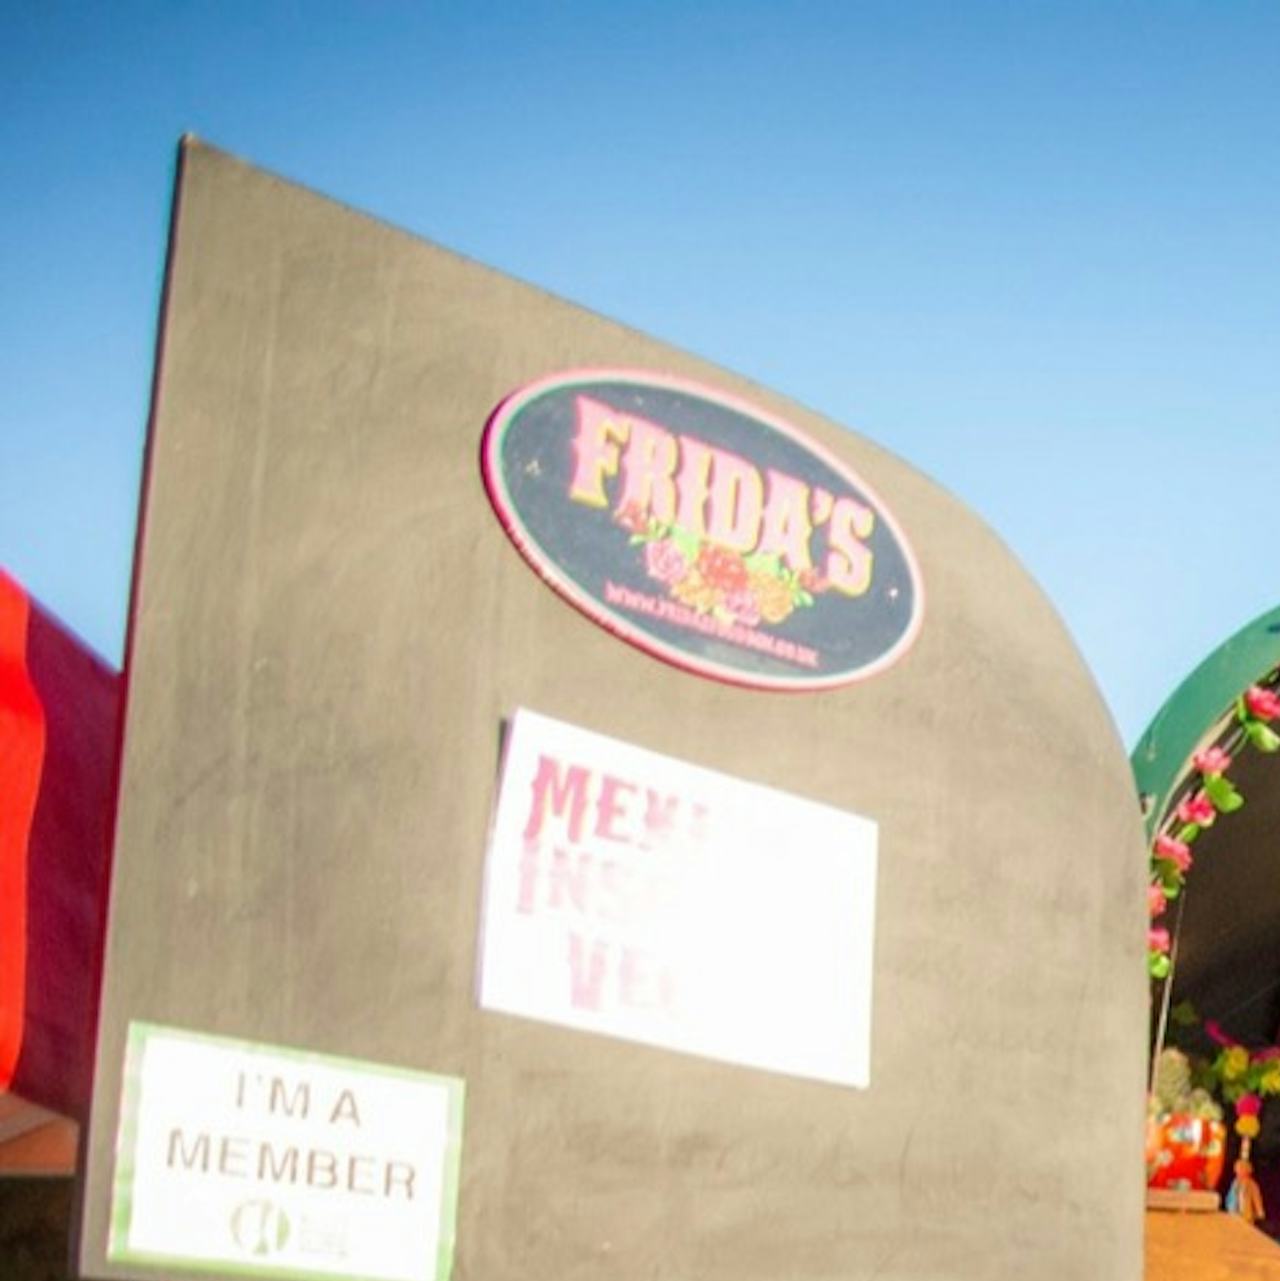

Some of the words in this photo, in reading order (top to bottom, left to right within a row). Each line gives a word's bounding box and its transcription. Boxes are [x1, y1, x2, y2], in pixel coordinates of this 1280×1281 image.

[570, 395, 875, 596] FRIDA'S
[236, 1071, 311, 1121] I'M
[329, 1088, 362, 1128] A
[166, 1128, 418, 1201] MEMBER
